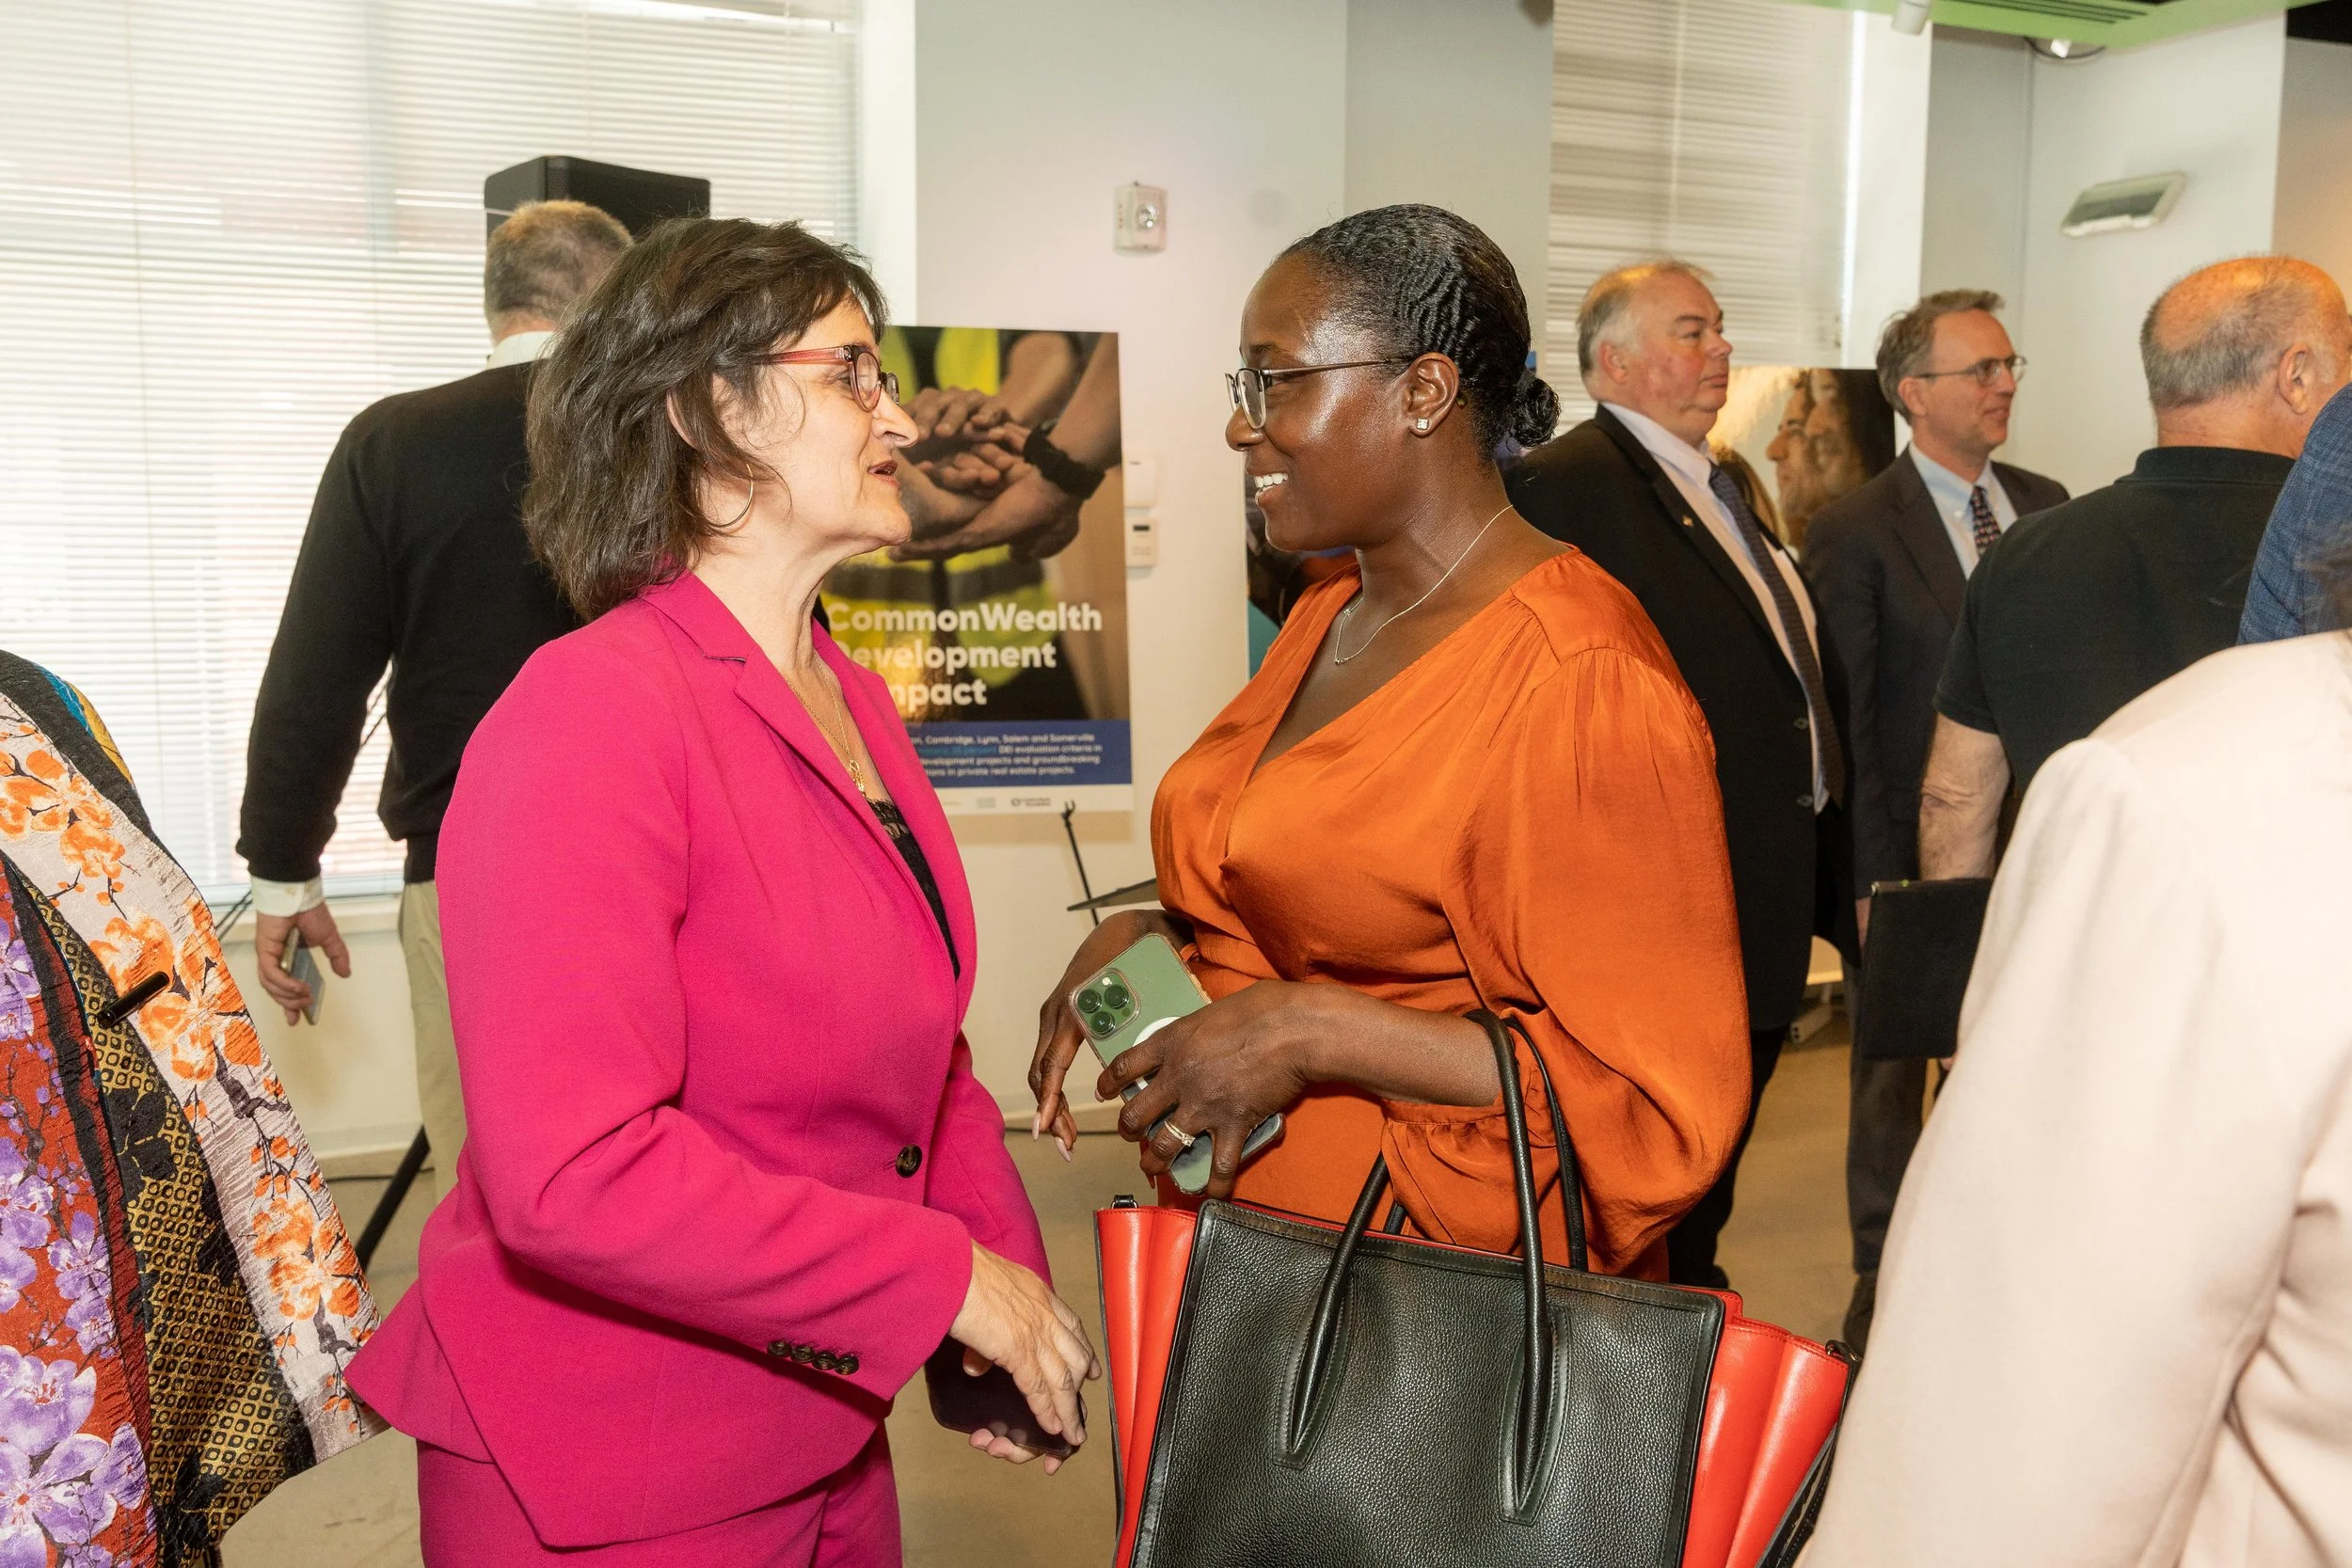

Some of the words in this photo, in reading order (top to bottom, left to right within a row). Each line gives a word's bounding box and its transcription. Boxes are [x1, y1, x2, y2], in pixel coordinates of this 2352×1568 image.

[828, 601, 1103, 632] CommonWealth
[837, 639, 1057, 676] evelopment
[1031, 733, 1049, 744] and
[1049, 733, 1096, 744] Somerville
[1013, 755, 1031, 765] and
